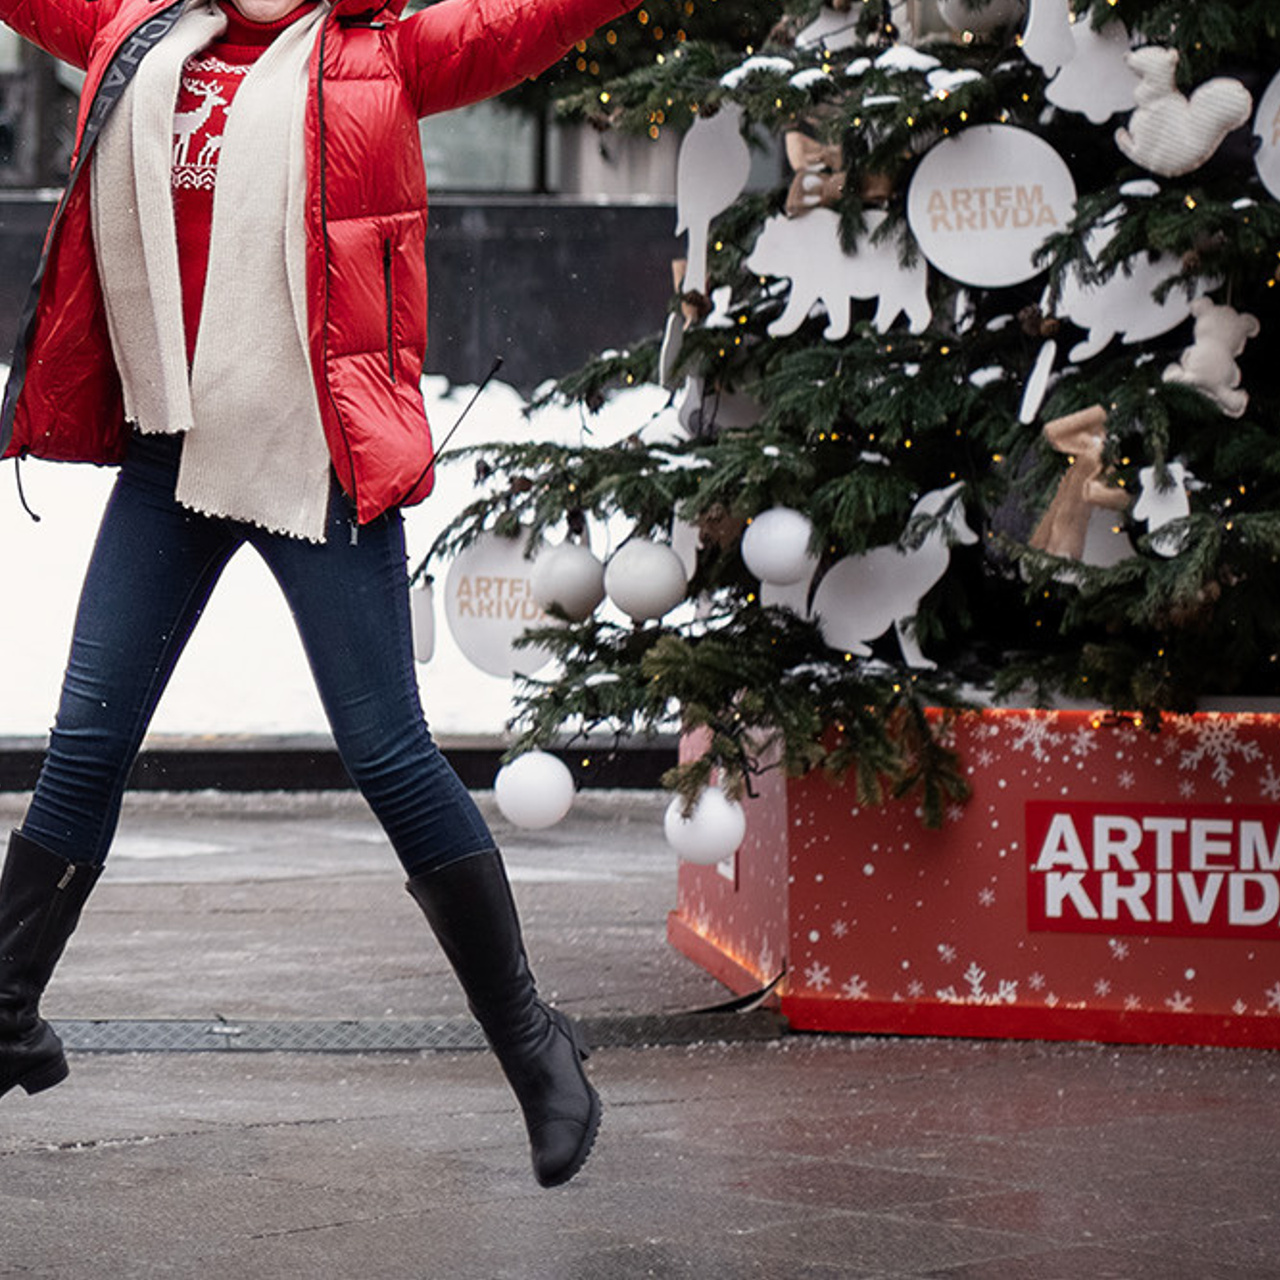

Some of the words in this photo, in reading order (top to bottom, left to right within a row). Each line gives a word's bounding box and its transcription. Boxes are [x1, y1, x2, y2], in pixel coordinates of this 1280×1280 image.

[926, 184, 1045, 214] ARTEM
[930, 203, 1058, 233] KRIVDA
[1035, 813, 1280, 871] ARTEM
[1044, 872, 1280, 927] KRIVD
